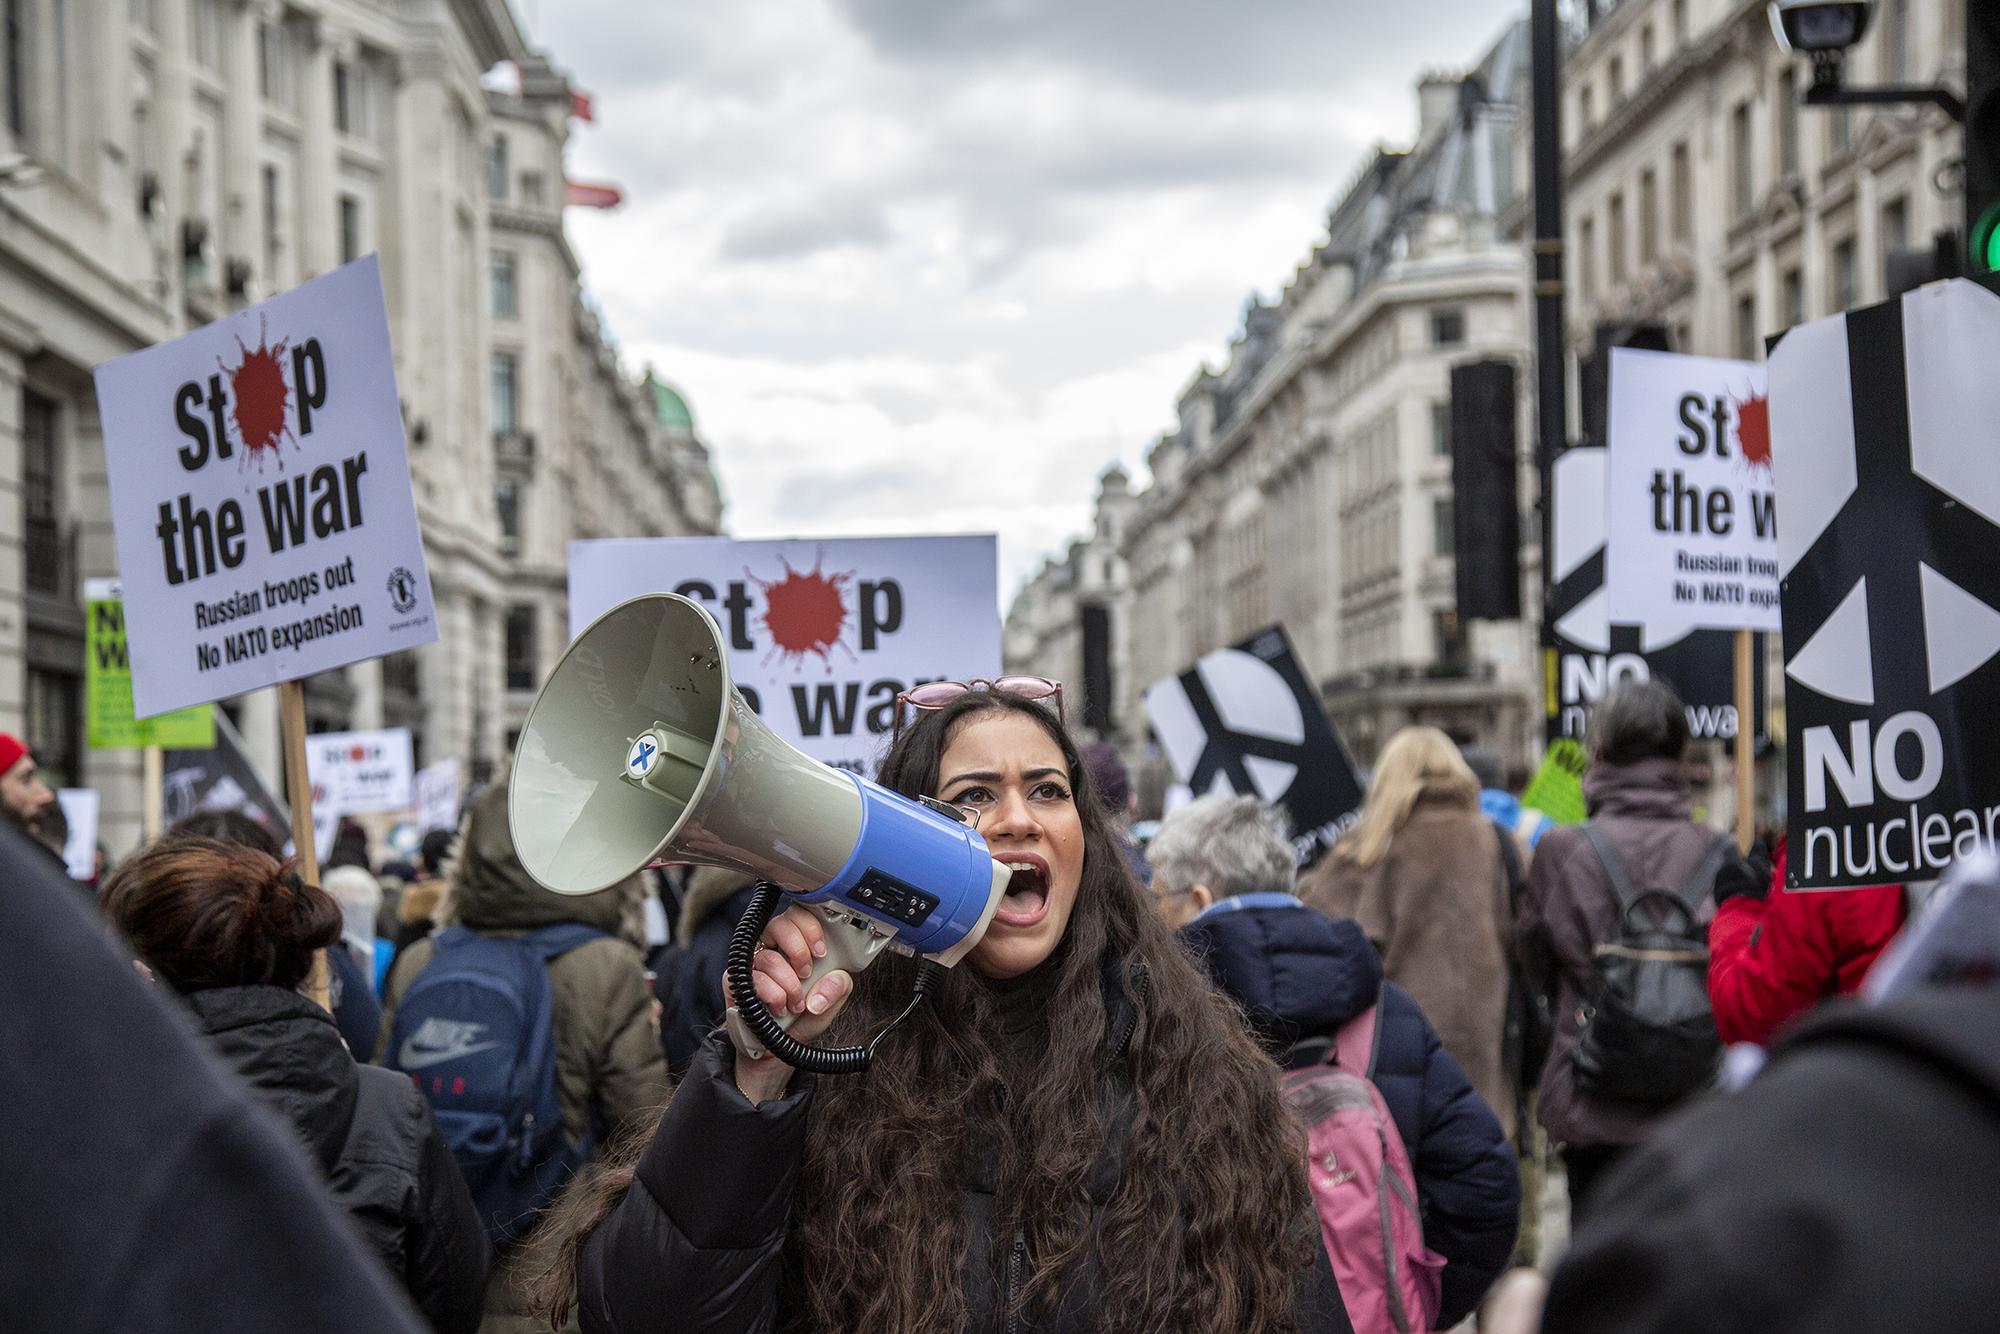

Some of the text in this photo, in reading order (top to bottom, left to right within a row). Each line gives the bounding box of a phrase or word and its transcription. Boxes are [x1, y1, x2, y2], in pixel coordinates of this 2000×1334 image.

[156, 450, 368, 587] the war
[1650, 468, 1734, 537] the
[194, 589, 262, 630] Russian
[263, 571, 320, 608] troops
[324, 555, 355, 591] out
[1674, 580, 1697, 603] No
[1702, 582, 1745, 604] NATO
[1677, 550, 1742, 573] Russian
[196, 641, 221, 672] No
[224, 625, 267, 664] NATO
[271, 603, 363, 651] expansion
[1802, 710, 1944, 813] NO
